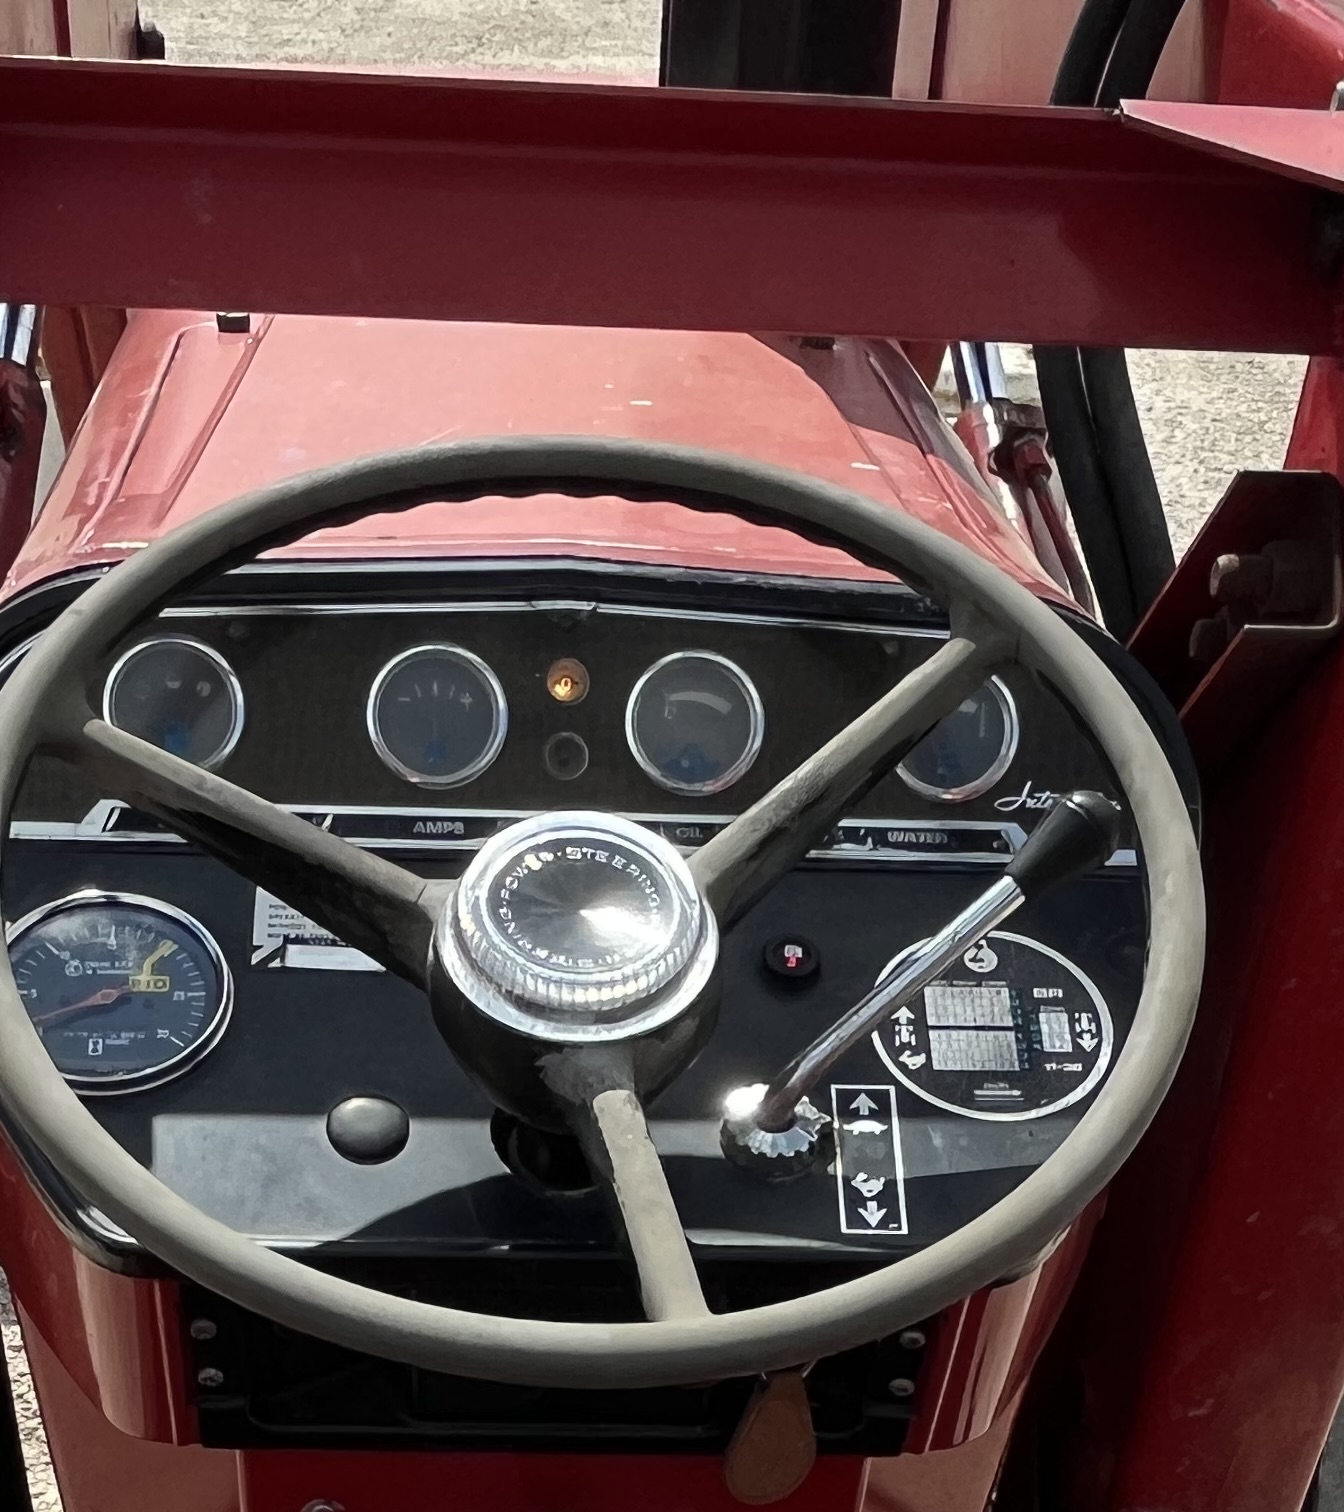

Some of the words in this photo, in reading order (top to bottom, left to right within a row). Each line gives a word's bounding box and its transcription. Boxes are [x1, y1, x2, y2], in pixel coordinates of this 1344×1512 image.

[413, 821, 465, 834] AMPS
[887, 830, 948, 844] WATER
[565, 846, 660, 907] STEERING
